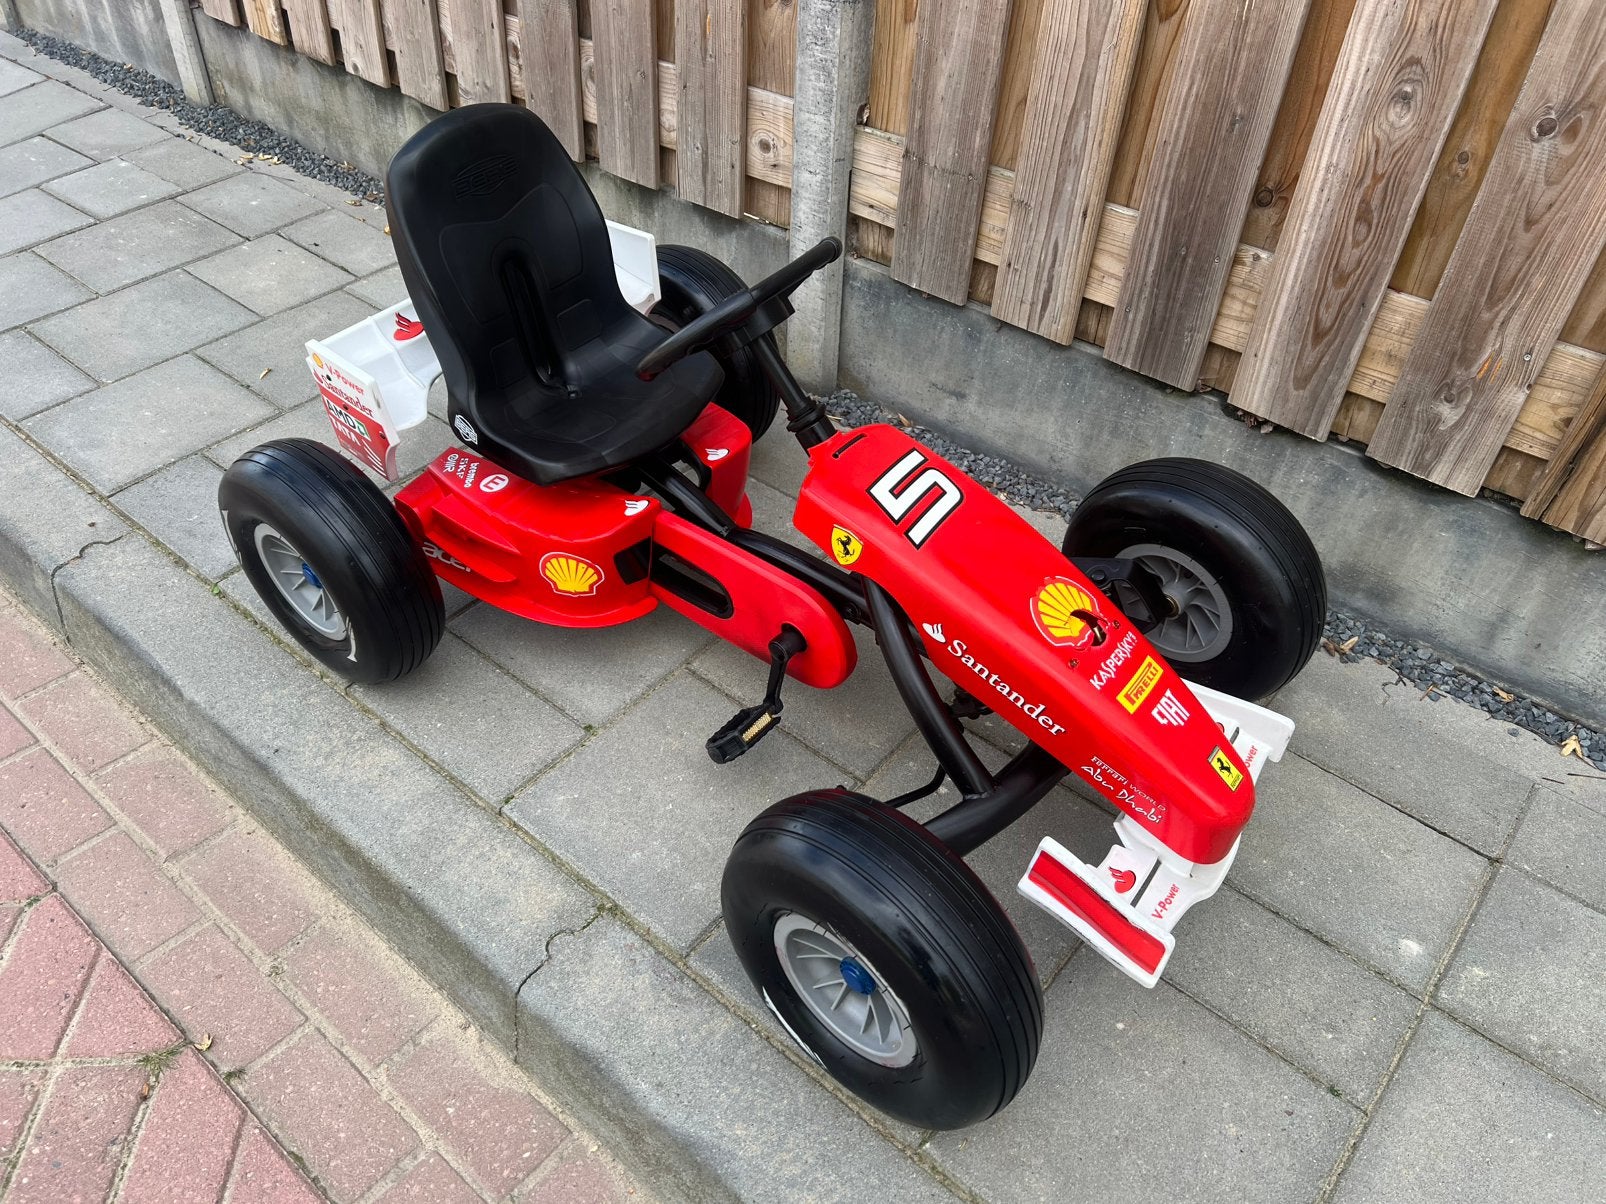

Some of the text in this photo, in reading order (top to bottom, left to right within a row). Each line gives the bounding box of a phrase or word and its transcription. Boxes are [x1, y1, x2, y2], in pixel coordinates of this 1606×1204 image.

[321, 375, 375, 418] Santander
[325, 363, 364, 395] V-Power
[325, 399, 355, 429] AMD
[456, 457, 469, 479] SKF
[463, 462, 480, 488] brembo
[866, 447, 964, 551] 5
[1089, 632, 1136, 690] KASPERSKY
[947, 639, 1066, 736] Santander
[1123, 660, 1159, 706] PIRELLI
[1151, 688, 1190, 726] FIAT
[1080, 765, 1163, 824] Abu Dhabi
[1129, 783, 1167, 812] WORLD
[1151, 884, 1180, 920] V-Power
